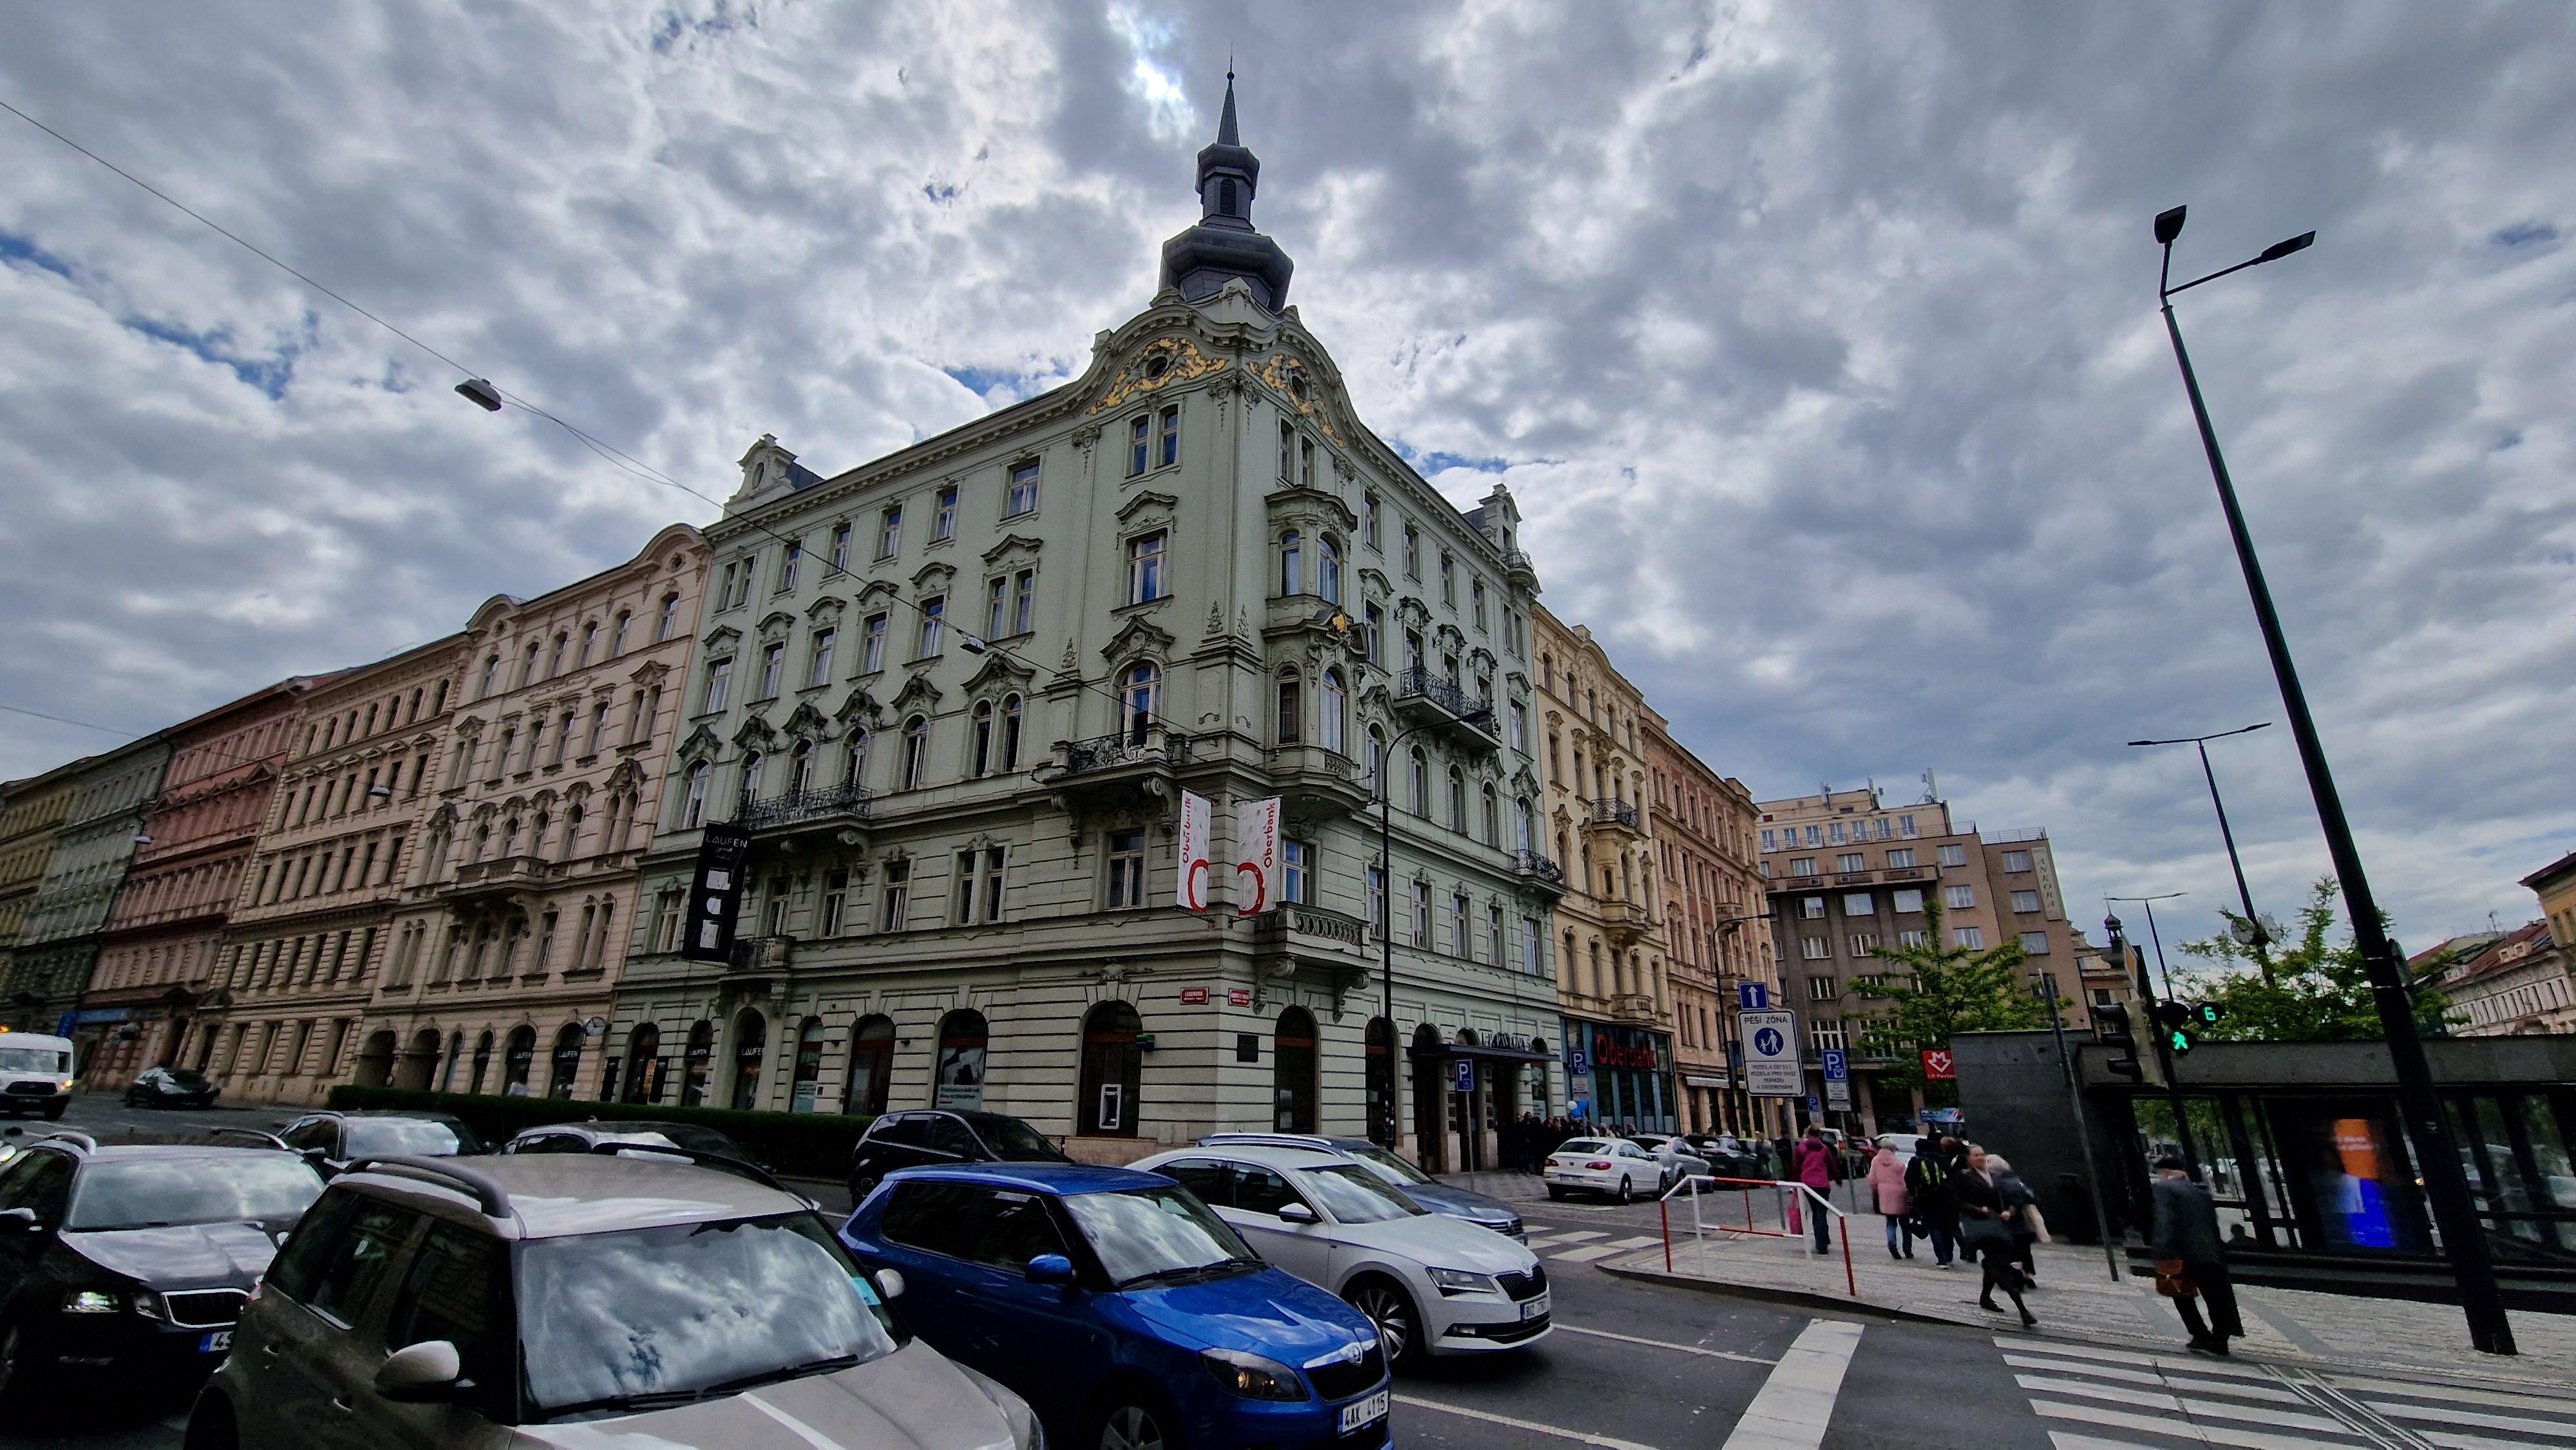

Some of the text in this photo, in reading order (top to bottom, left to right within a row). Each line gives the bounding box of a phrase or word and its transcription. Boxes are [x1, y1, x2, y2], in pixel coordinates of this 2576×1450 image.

[706, 834, 748, 848] LAUFEN
[1264, 802, 1276, 869] Oberbank
[2204, 1006, 2217, 1021] 6
[1596, 1033, 1657, 1069] Oberbank
[1573, 1053, 1583, 1068] P
[1826, 1053, 1840, 1071] P
[1459, 1063, 1468, 1081] P
[1345, 1406, 1361, 1427] 4AK
